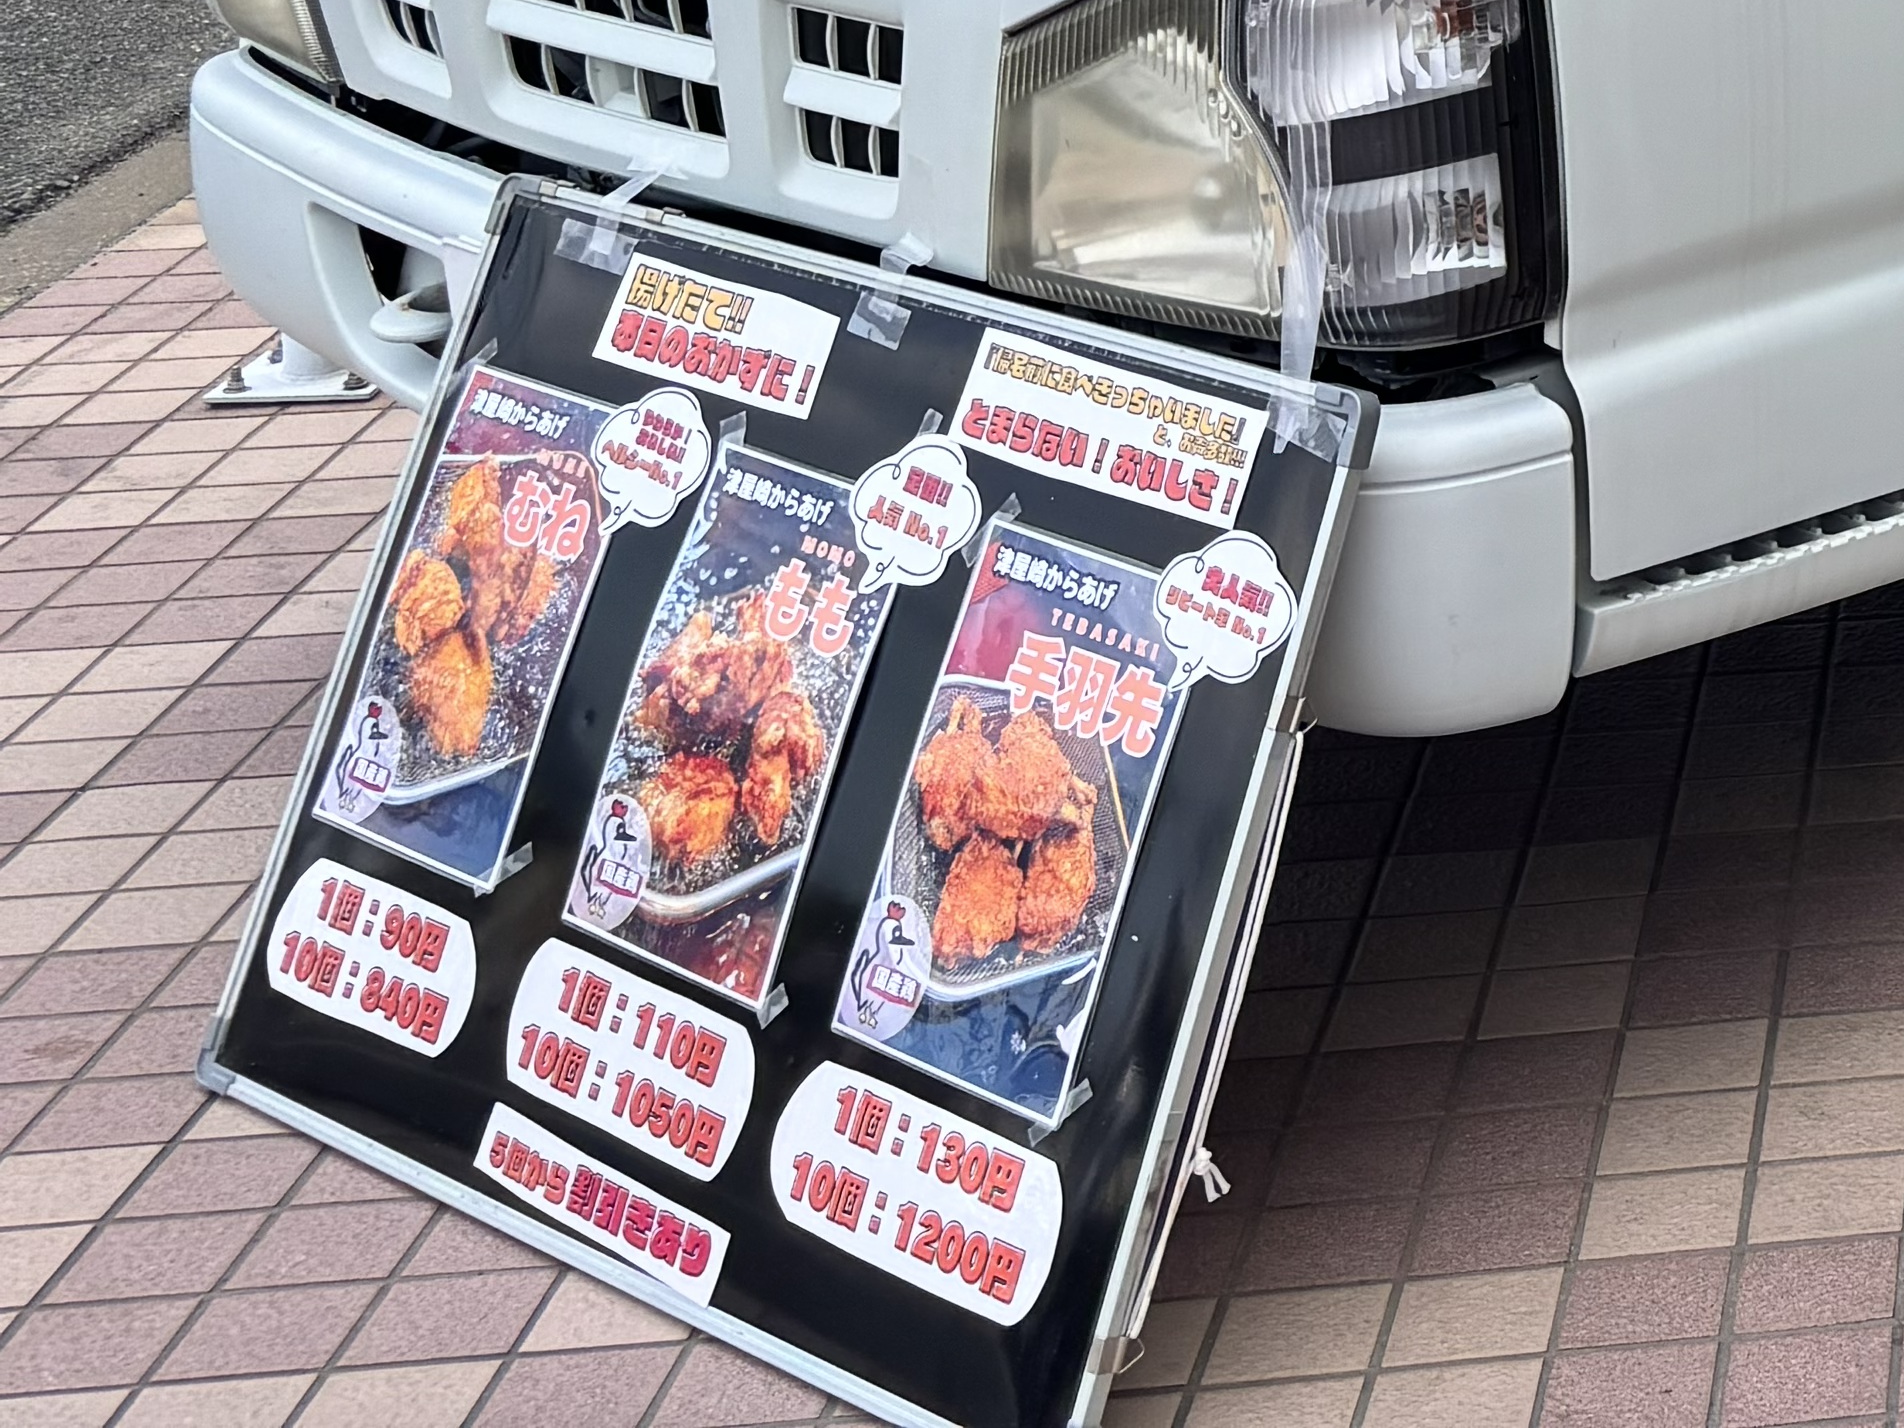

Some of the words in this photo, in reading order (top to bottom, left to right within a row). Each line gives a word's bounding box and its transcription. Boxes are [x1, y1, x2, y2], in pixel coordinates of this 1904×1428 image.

[504, 469, 591, 562] むね
[723, 467, 835, 525] 津屋崎からあげ
[867, 495, 905, 531] 人気
[801, 535, 856, 567] MOMO
[992, 545, 1120, 611] 津屋崎からあげ
[765, 557, 857, 657] もも
[1051, 608, 1160, 661] TEBASAKI
[1231, 615, 1267, 645] No.1
[1005, 630, 1167, 758] 手羽先
